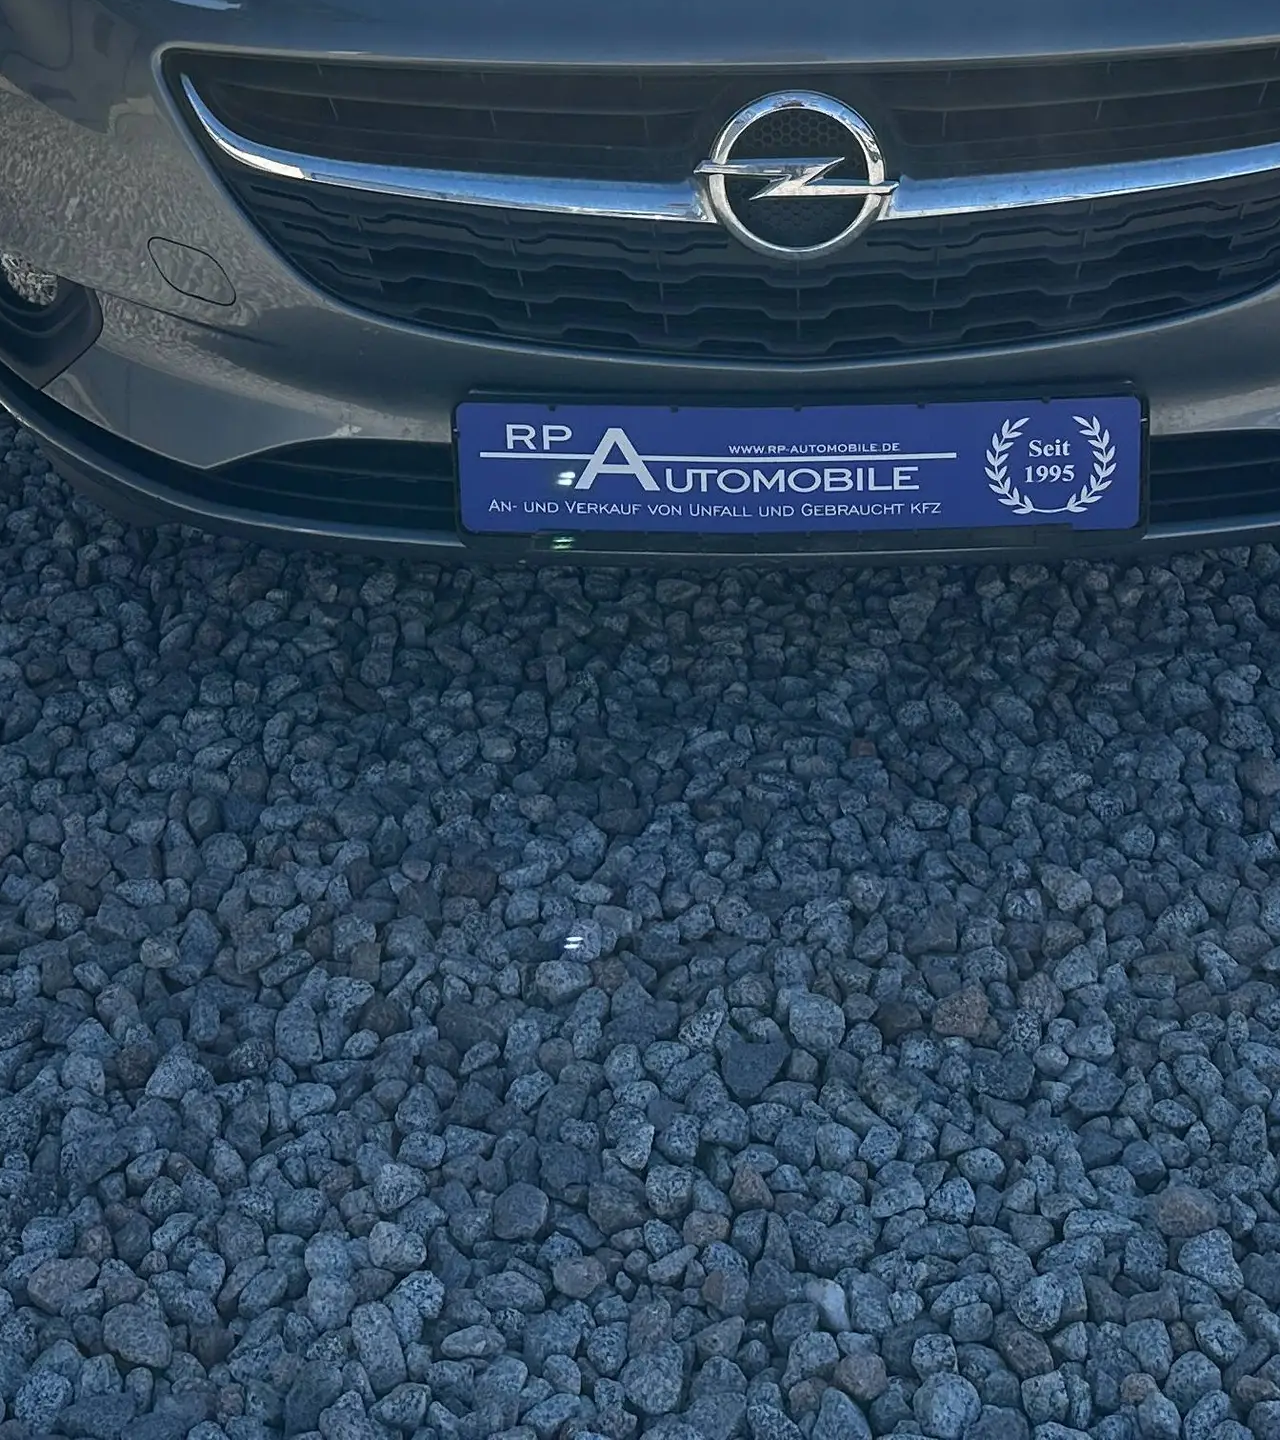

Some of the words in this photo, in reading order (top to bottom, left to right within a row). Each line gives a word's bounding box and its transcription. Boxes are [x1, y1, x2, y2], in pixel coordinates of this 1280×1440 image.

[505, 423, 573, 450] RP
[728, 442, 901, 454] WWW.RP-AUTOMOBILE.DE
[1028, 439, 1071, 458] Seit
[1024, 464, 1075, 483] 1995
[564, 501, 642, 515] VERKAUF
[647, 504, 682, 516] VON
[689, 503, 753, 517] UNFALL
[759, 505, 795, 517] UND
[801, 502, 905, 517] GEBRAUCHT
[910, 502, 942, 514] KFZ
